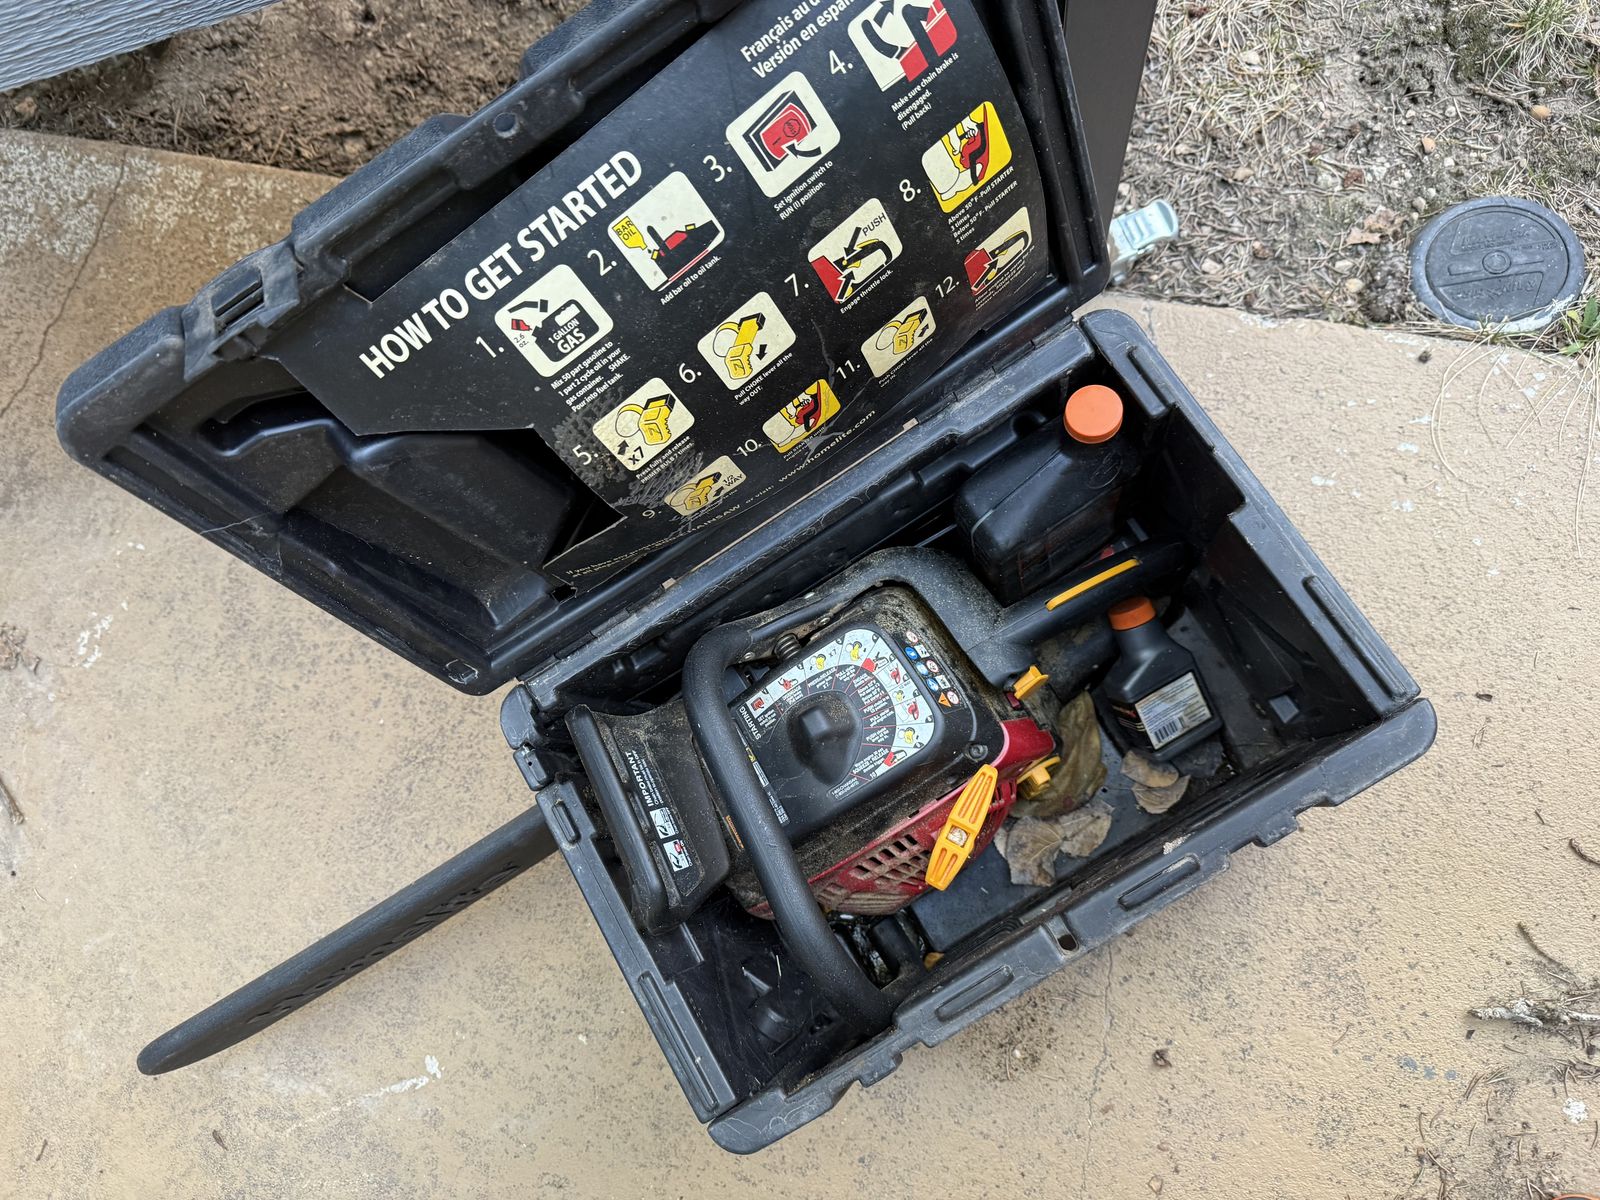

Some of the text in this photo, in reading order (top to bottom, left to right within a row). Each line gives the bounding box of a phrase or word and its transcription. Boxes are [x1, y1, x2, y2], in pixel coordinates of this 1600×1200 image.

[740, 1, 811, 63] Français au
[751, 37, 802, 78] Versión
[800, 23, 819, 41] en
[829, 50, 854, 76] 4.
[891, 52, 959, 113] Make sure chain brake is
[897, 88, 933, 121] disengaged.
[901, 101, 932, 131] (Pull back)
[702, 154, 733, 183] 3.
[773, 160, 833, 212] Set ignition switch to
[898, 178, 922, 202] 8.
[947, 208, 966, 225] Above
[990, 165, 1014, 189] STARTER
[779, 205, 795, 221] RUN
[799, 181, 825, 206] position.
[952, 222, 970, 239] Below
[994, 180, 1018, 203] STARTER
[614, 220, 635, 237] BAR
[622, 228, 637, 241] OIL
[863, 212, 888, 237] PUSH
[954, 213, 970, 228] times
[959, 227, 975, 241] times
[358, 150, 642, 379] HOW TO GET STARTED
[586, 249, 618, 277] 2.
[660, 255, 722, 306] Add bar oil to oil tank.
[783, 272, 810, 297] 7.
[839, 269, 894, 314] Engage throttle lock.
[934, 273, 961, 299] 12.
[513, 332, 526, 344] 2.6
[552, 318, 580, 341] GALLON
[557, 327, 586, 354] GAS
[475, 336, 505, 360] 1.
[518, 340, 530, 349] oz.
[550, 341, 614, 390] Mix 50 part gasoline to
[562, 381, 577, 396] part
[573, 378, 582, 386] 2
[579, 368, 596, 382] cycle
[593, 361, 603, 372] oil
[599, 357, 609, 366] in
[606, 347, 622, 362] your
[678, 362, 702, 384] 6.
[734, 352, 793, 401] Pull CHOKE lever all the
[836, 359, 861, 379] 11.
[565, 353, 631, 407] gas container. SHAKE.
[571, 372, 624, 413] Pour into fuel tank.
[738, 385, 762, 406] way OUT.
[572, 444, 599, 466] 5.
[627, 445, 645, 466] x7
[635, 435, 691, 480] Press fully and release
[736, 438, 762, 457] 10.
[777, 408, 877, 485] www.homelite.com
[724, 473, 743, 487] WAY
[641, 504, 663, 520] 9.
[739, 705, 762, 741] STARTING
[625, 751, 654, 807] IMPORTANT
